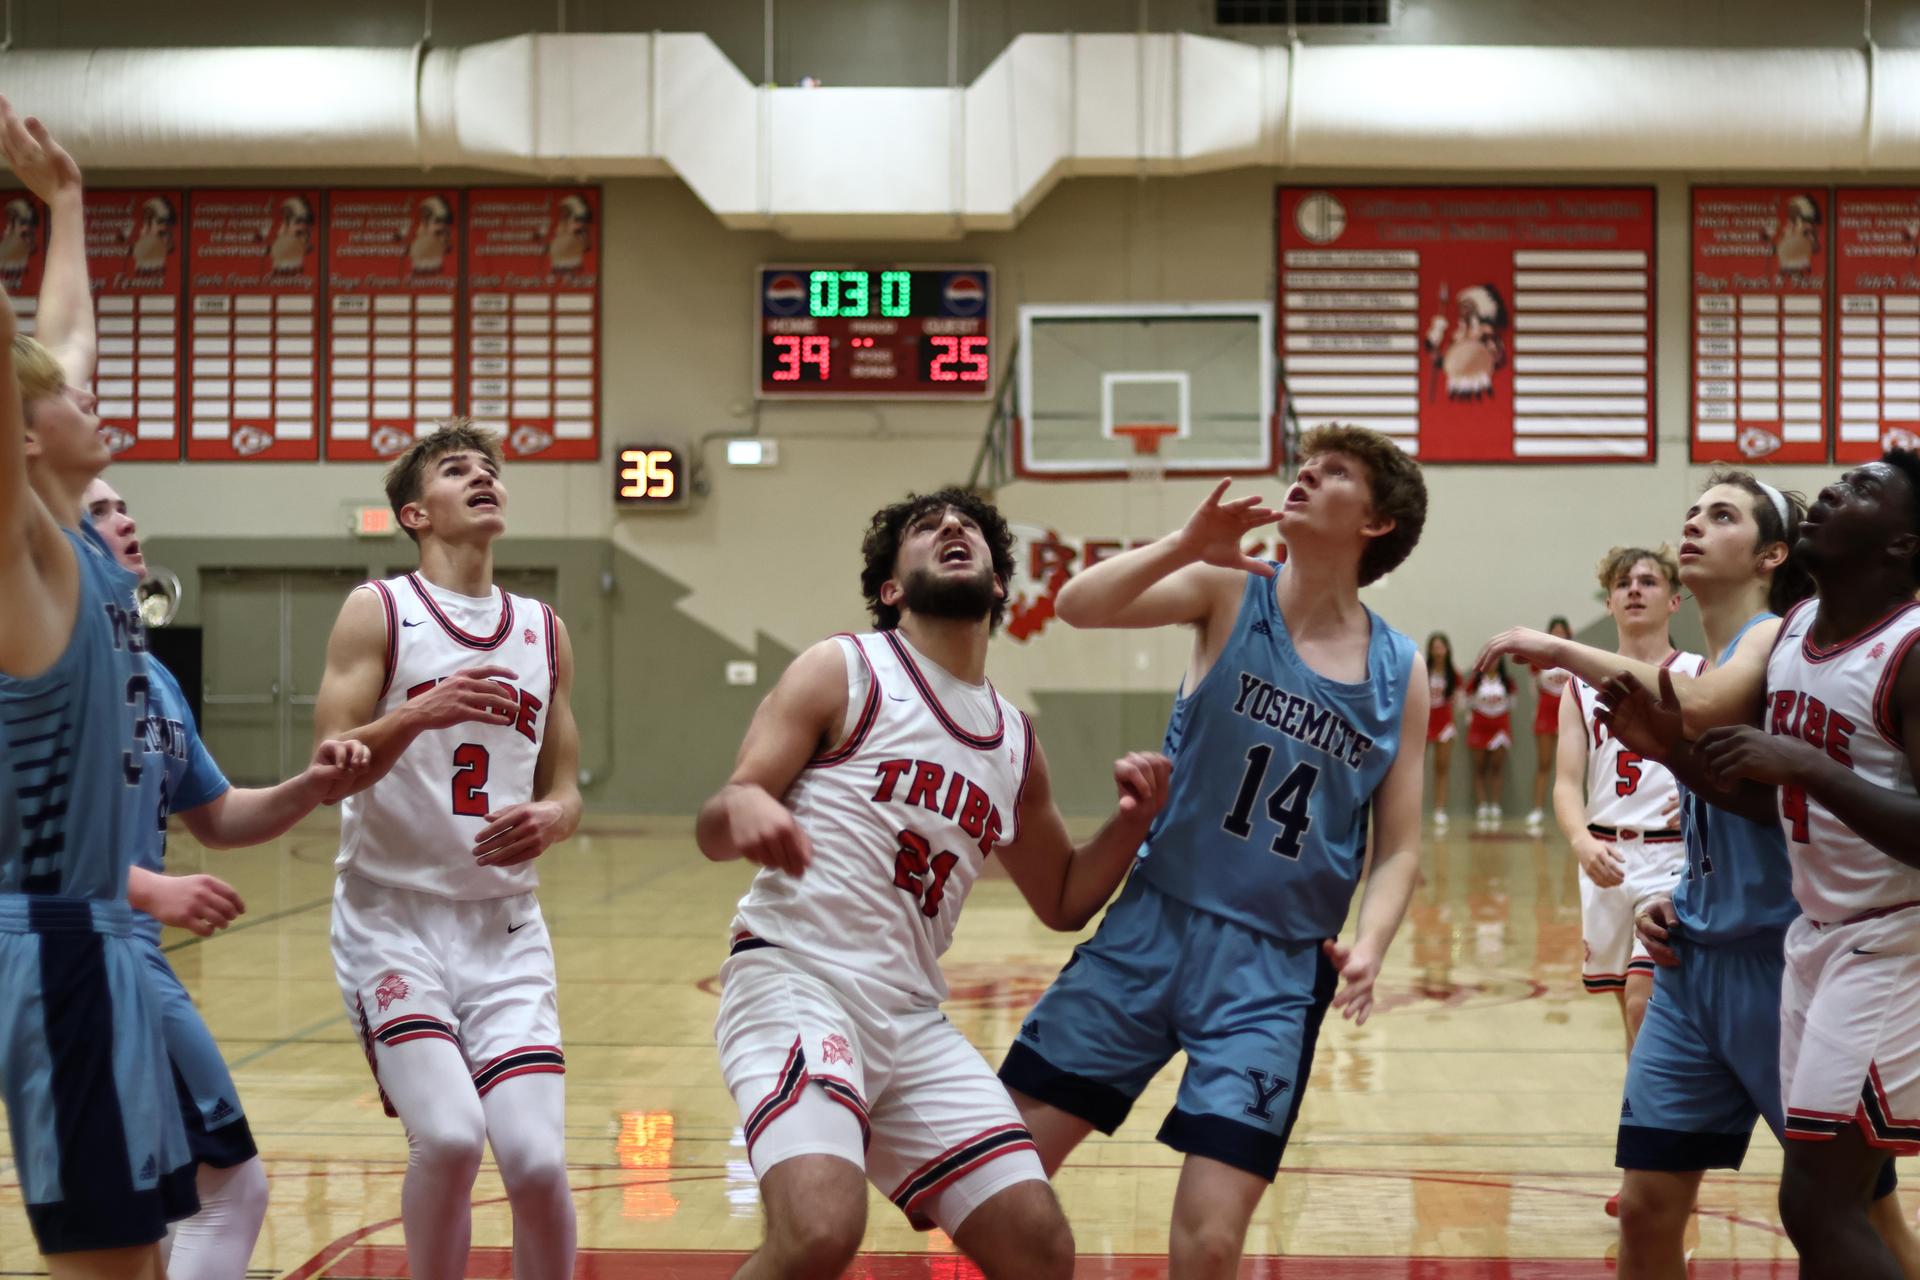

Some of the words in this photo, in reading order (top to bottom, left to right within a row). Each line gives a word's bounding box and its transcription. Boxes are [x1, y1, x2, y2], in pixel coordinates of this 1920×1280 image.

[772, 336, 830, 380] 39
[930, 336, 988, 381] 25
[620, 450, 674, 498] 35
[1232, 670, 1375, 772] YOSEMITE
[452, 743, 489, 816] 2
[1221, 742, 1320, 861] 14
[1616, 750, 1644, 798] 5
[893, 828, 959, 919] 21
[1244, 1067, 1291, 1122] Y
